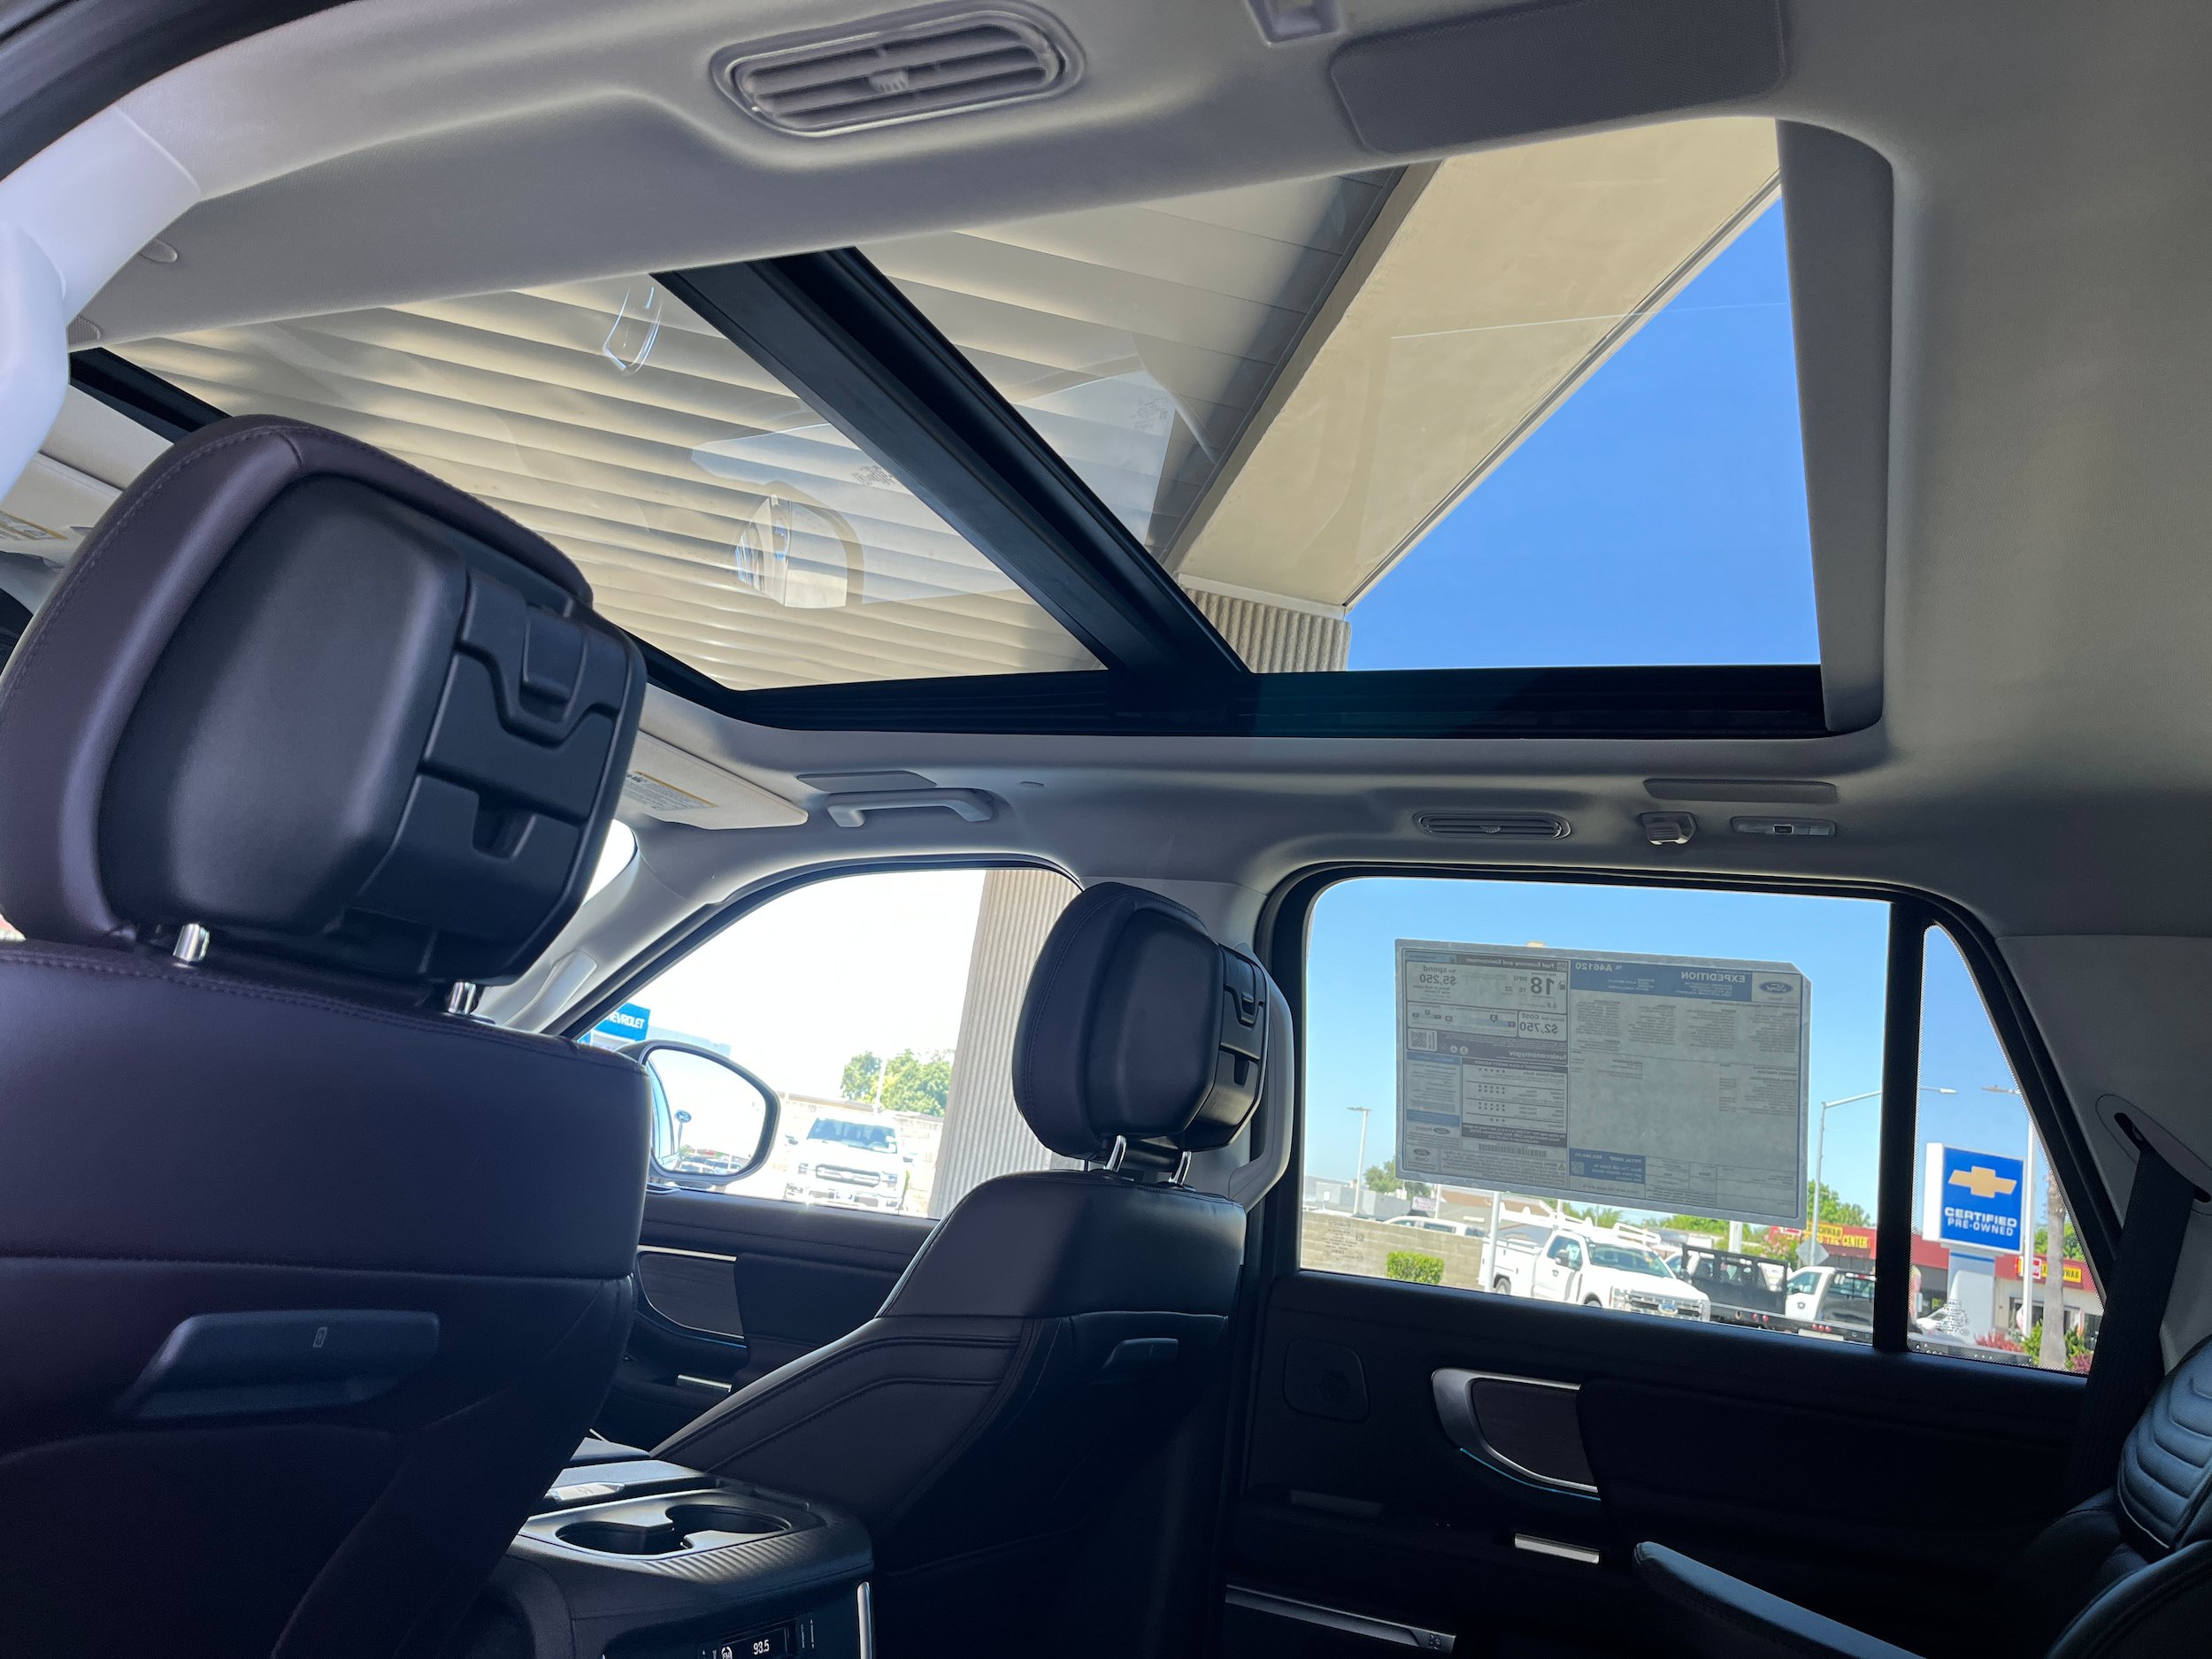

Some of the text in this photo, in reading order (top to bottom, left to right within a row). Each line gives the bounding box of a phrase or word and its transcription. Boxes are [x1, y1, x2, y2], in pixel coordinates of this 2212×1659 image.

[1945, 1206, 2017, 1228] CERTIFIED
[1947, 1217, 2014, 1237] PRE-OWNED
[1843, 1235, 1869, 1248] CENTER
[753, 1639, 770, 1655] 93.5
